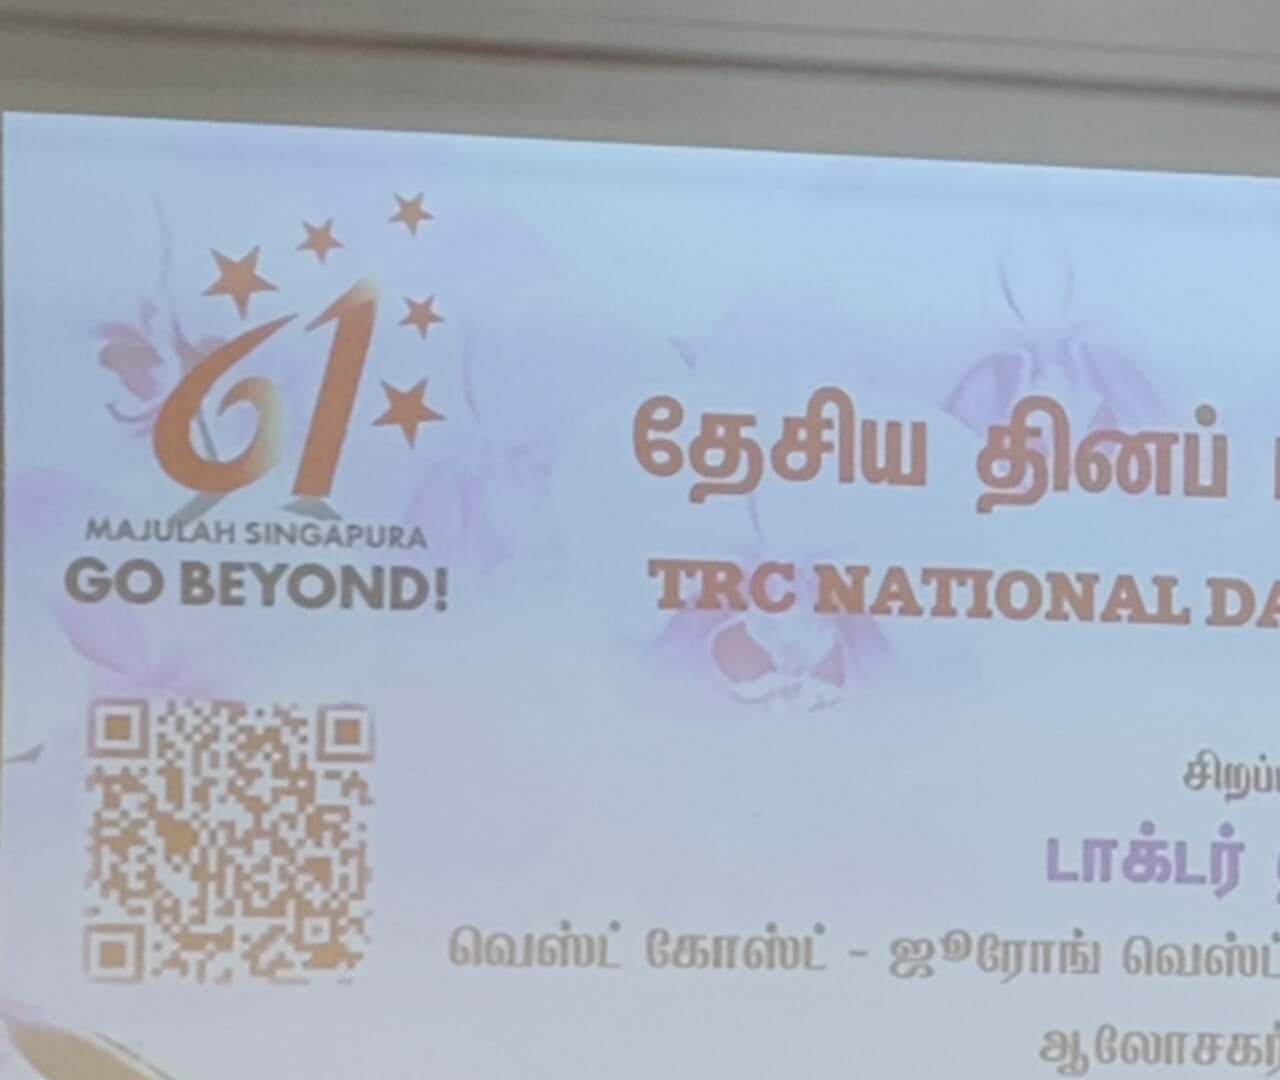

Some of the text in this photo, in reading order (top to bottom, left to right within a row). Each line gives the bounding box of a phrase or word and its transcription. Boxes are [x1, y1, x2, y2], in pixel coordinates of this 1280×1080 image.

[632, 386, 928, 504] தேசிய
[976, 395, 1228, 515] தினப்
[85, 511, 428, 550] MAJULAH SINGAPURA
[64, 556, 448, 612] GO BEYOND!
[647, 559, 796, 613] TRC
[813, 564, 1192, 626] NATIONAL
[1046, 820, 1246, 899] டாக்டர்
[448, 919, 621, 968] வெஸ்ட்
[645, 921, 826, 971] கோஸ்ட்
